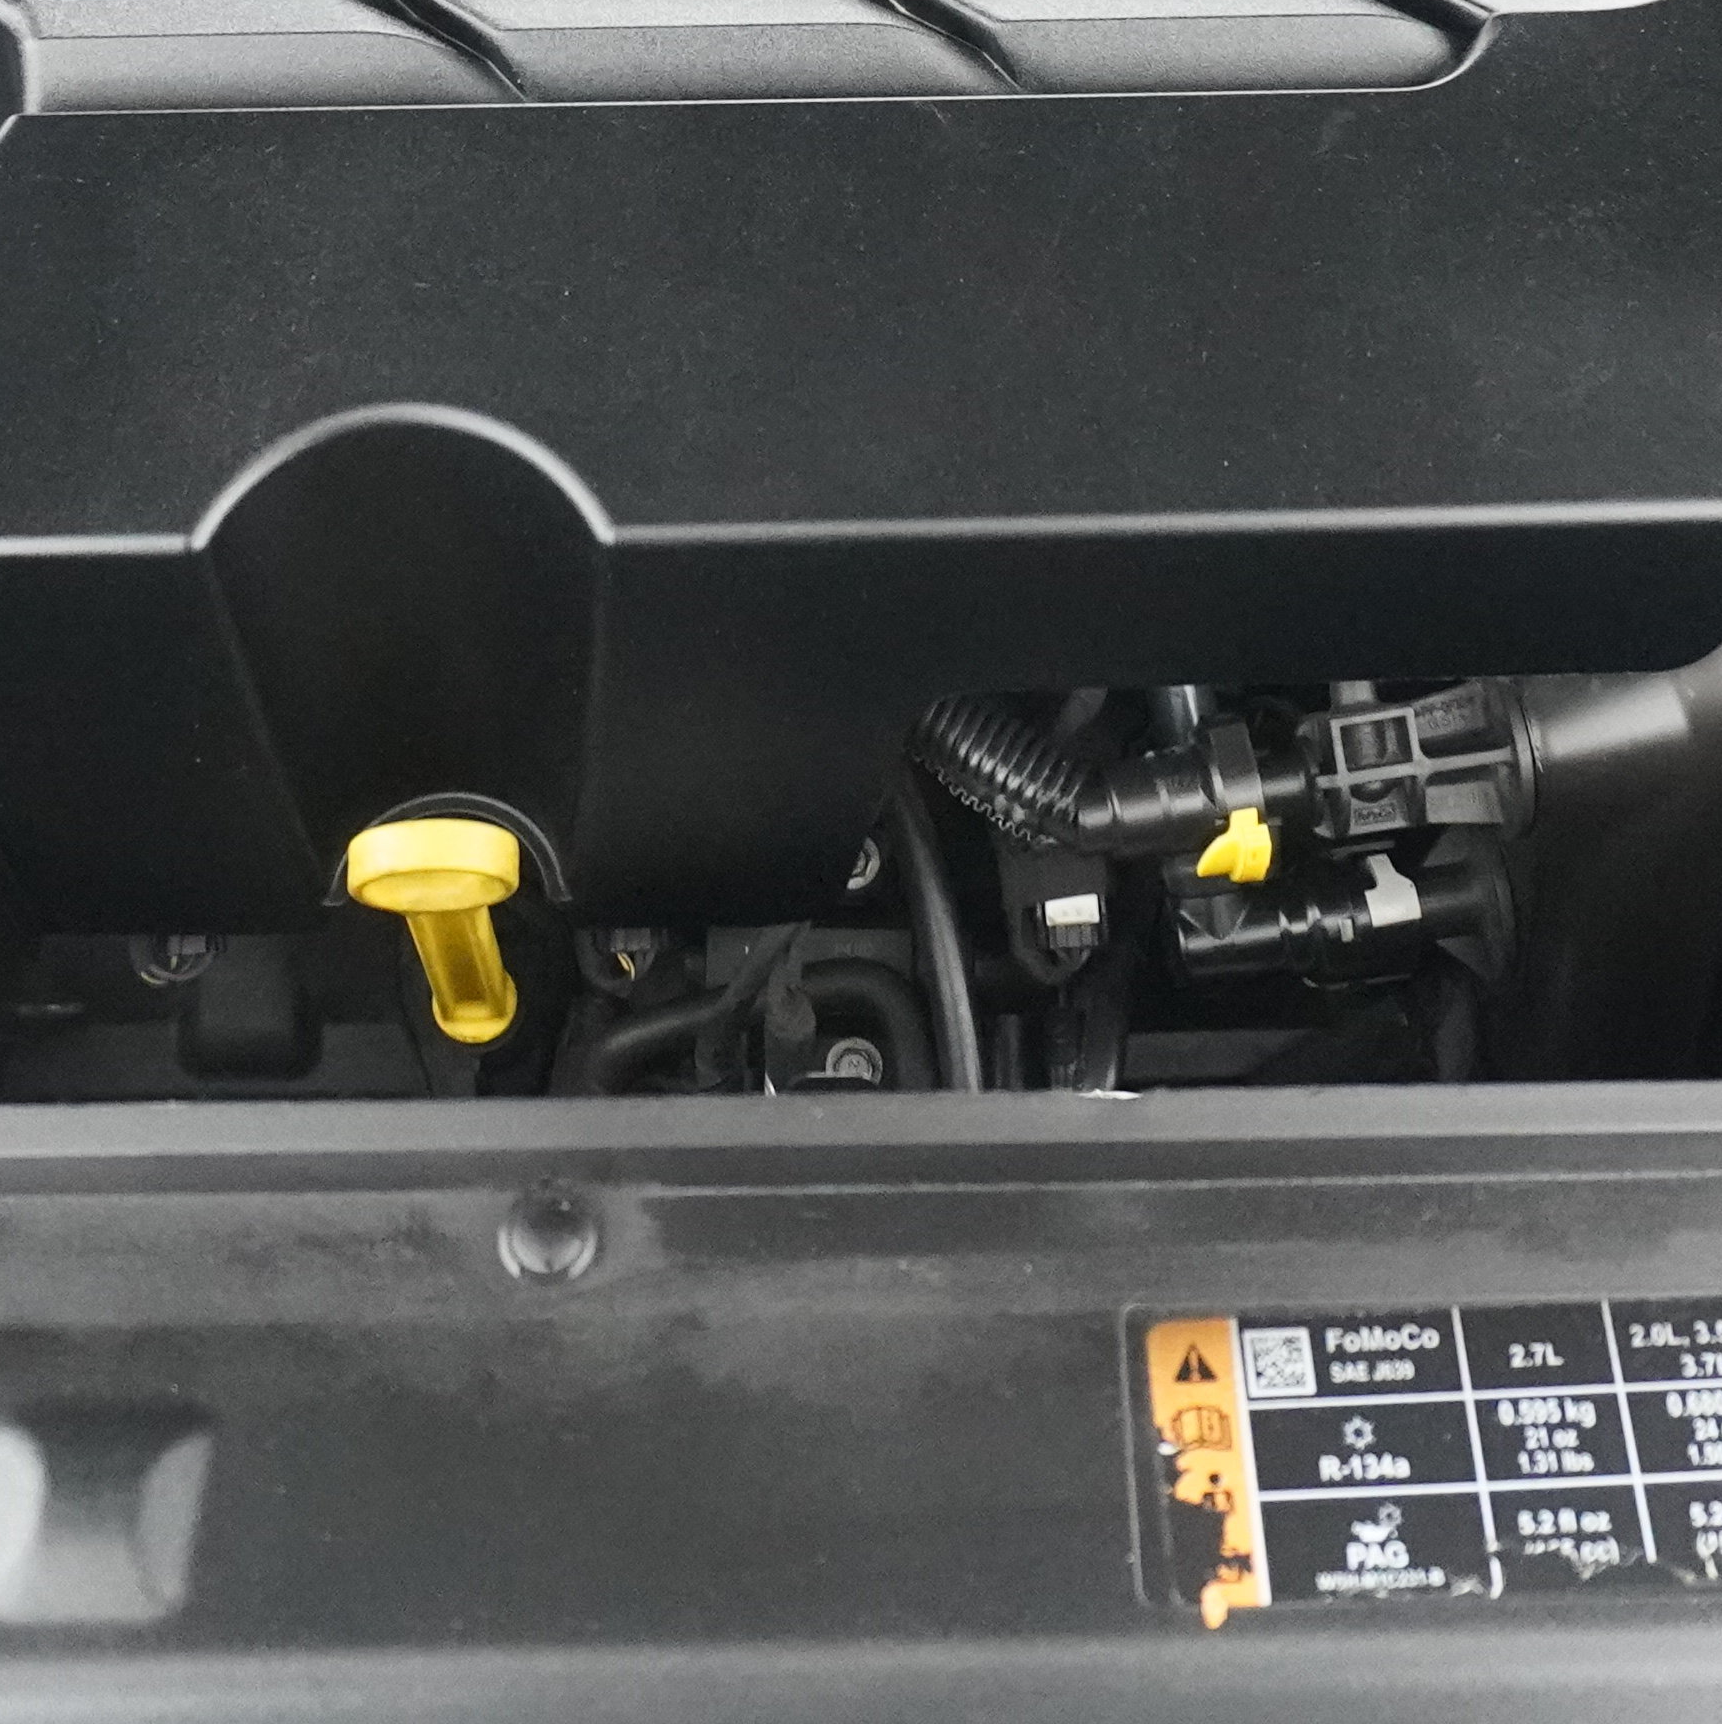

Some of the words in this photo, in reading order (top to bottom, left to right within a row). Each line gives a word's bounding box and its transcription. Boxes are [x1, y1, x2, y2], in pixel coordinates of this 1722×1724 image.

[1324, 1322, 1441, 1354] FoMoCo
[1628, 1322, 1691, 1348] 2.0L,
[1508, 1342, 1565, 1369] 2.7L
[1328, 1359, 1371, 1384] SAE
[1563, 1397, 1597, 1429] kg
[1524, 1426, 1549, 1450] 21
[1552, 1428, 1580, 1449] oz
[1318, 1452, 1411, 1482] R-134a
[1517, 1508, 1557, 1536] 5.2
[1346, 1540, 1410, 1570] PAG
